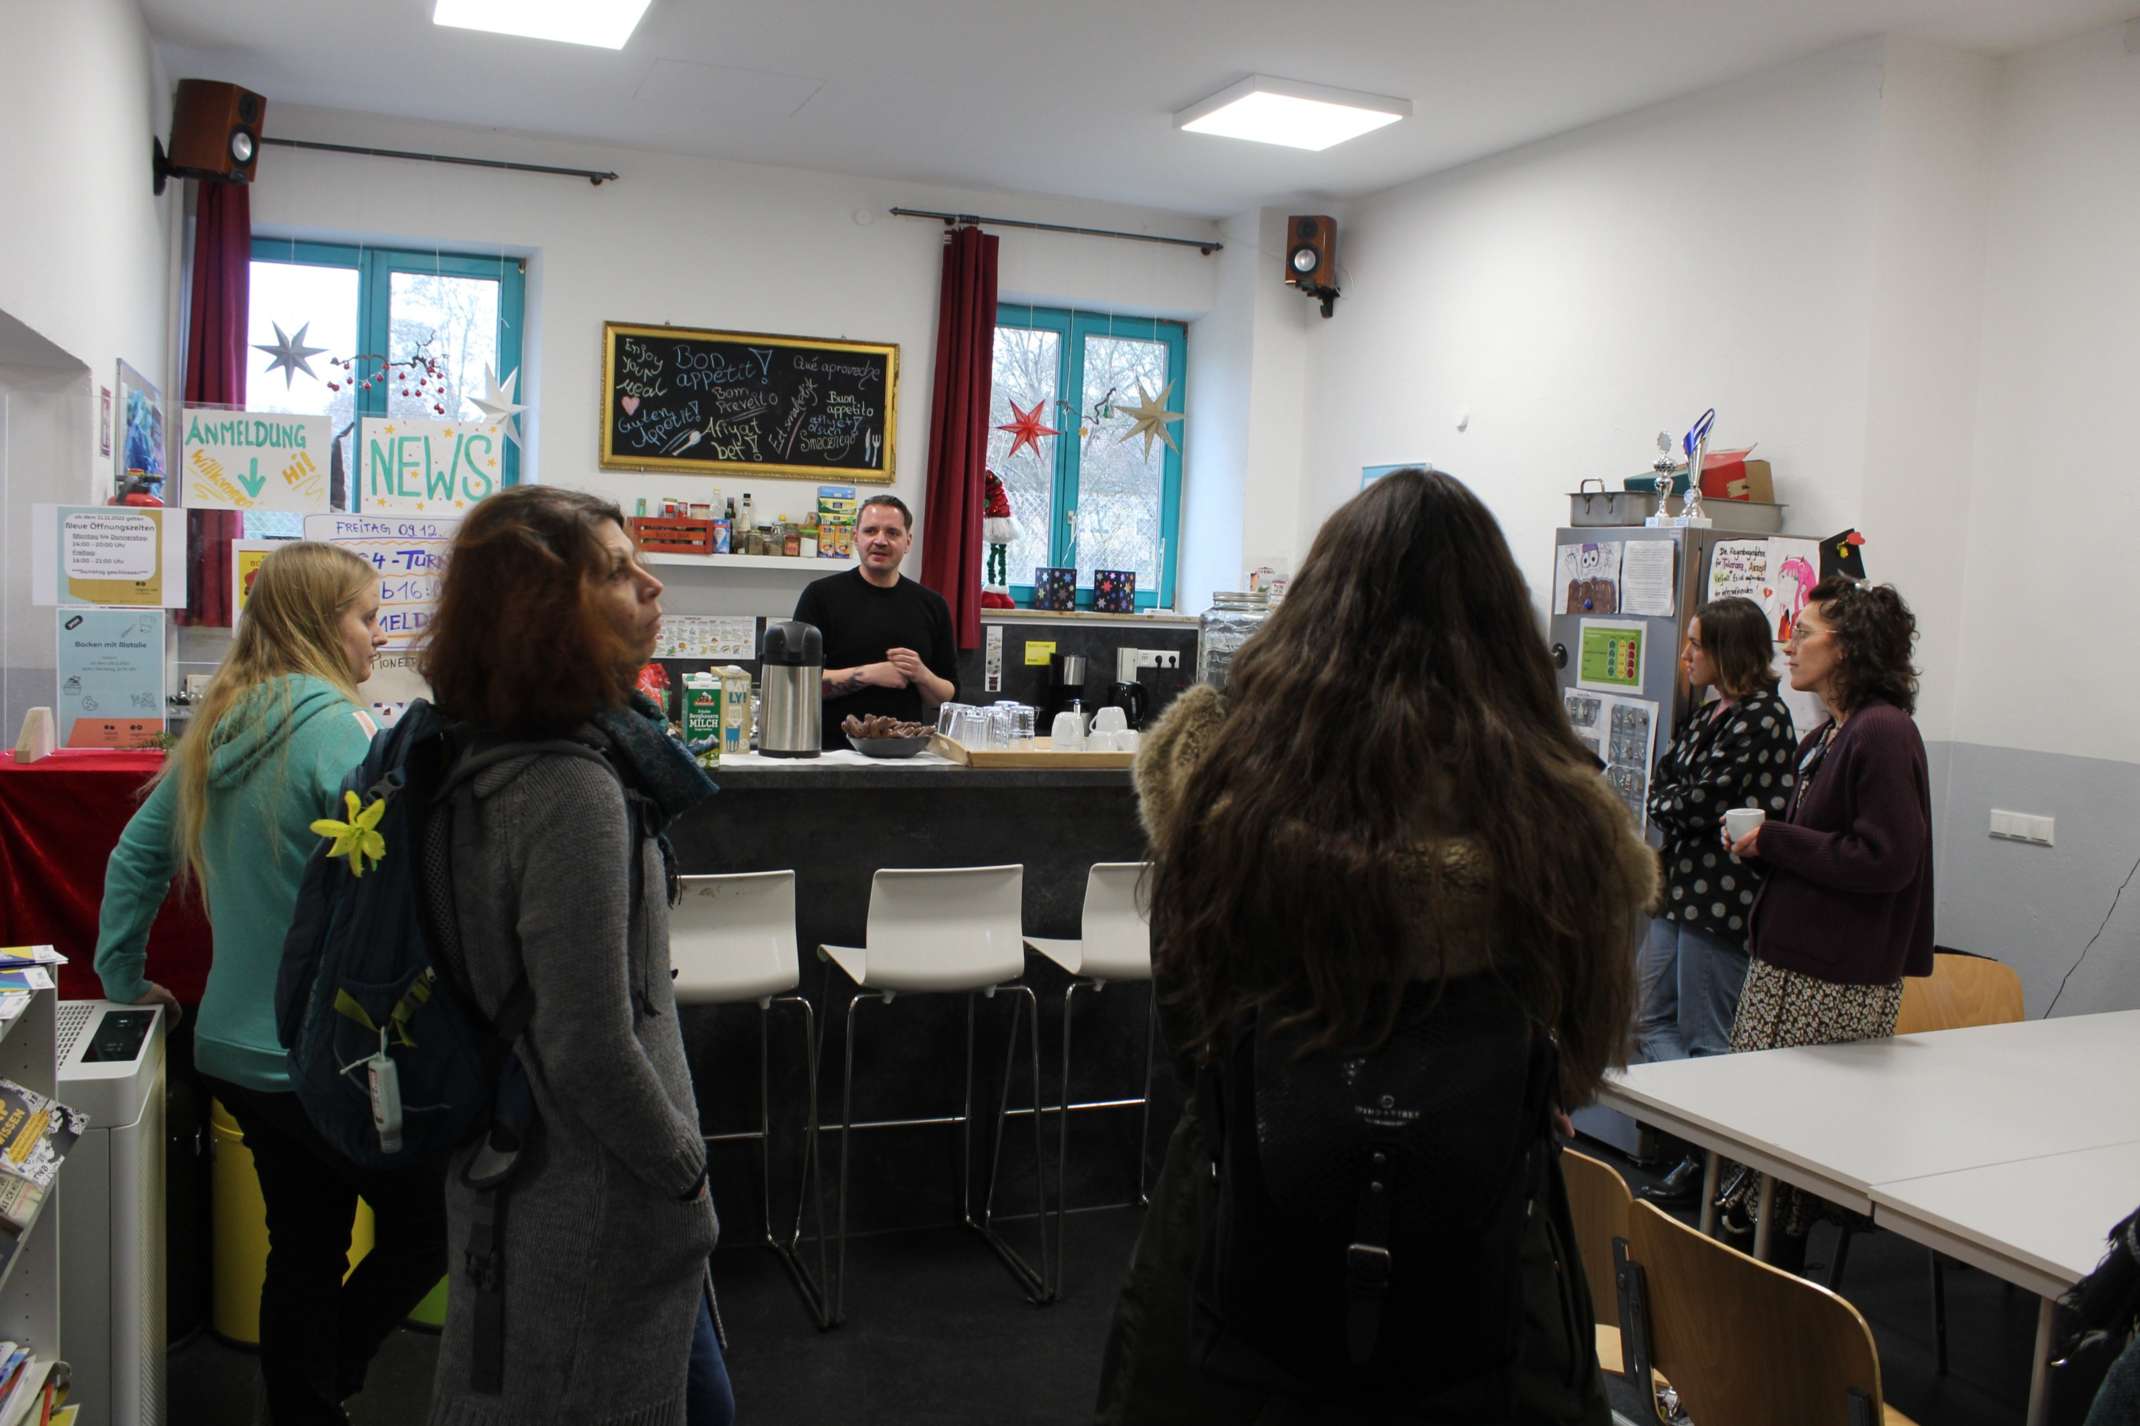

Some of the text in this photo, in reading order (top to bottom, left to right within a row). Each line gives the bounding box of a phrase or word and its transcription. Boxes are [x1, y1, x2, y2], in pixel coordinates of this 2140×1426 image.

[625, 338, 664, 373] Enjoy
[674, 344, 726, 369] Bon
[184, 415, 307, 449] ANMELDUNG
[618, 406, 673, 433] Guten
[370, 432, 493, 502] NEWS
[65, 522, 88, 530] Neue
[104, 641, 118, 649] mit
[689, 719, 719, 728] MILCH
